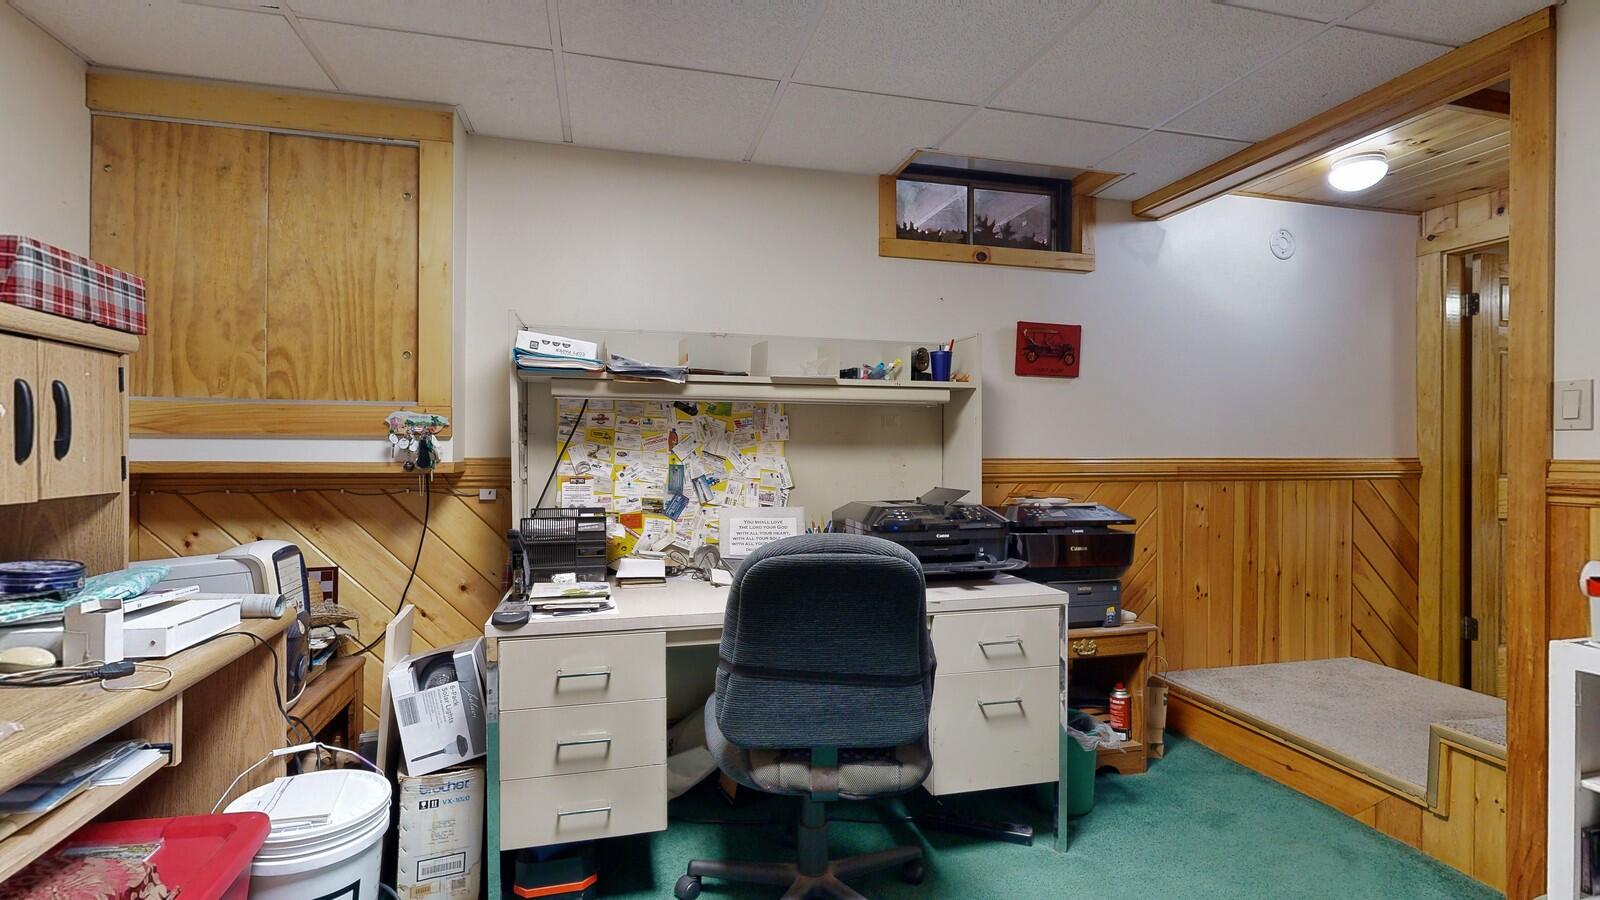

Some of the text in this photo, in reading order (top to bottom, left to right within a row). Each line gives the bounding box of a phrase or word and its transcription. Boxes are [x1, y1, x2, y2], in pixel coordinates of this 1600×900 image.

[442, 687, 454, 723] Solar Lights
[450, 685, 459, 706] 6-Pack
